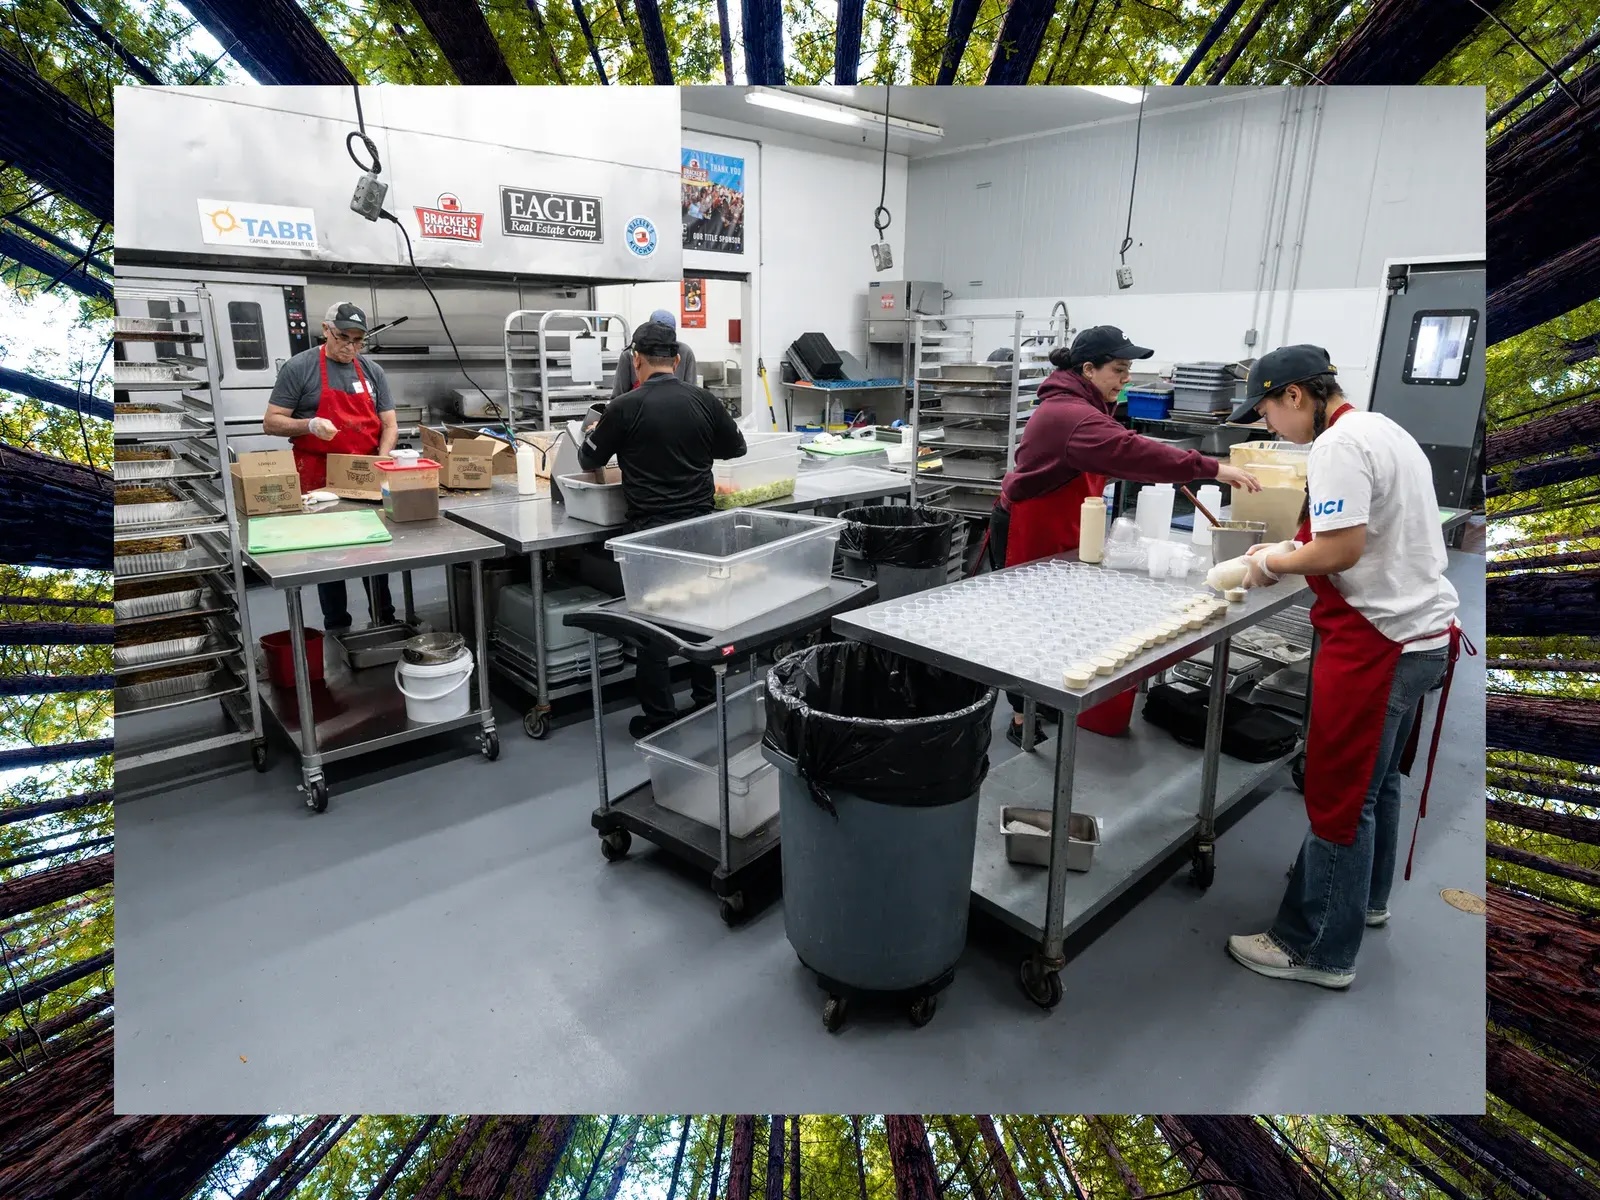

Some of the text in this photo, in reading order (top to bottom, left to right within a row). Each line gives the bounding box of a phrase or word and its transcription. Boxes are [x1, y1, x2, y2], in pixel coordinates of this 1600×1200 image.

[710, 163, 729, 174] THANK
[508, 191, 597, 225] EAGLE
[240, 217, 314, 241] TABR
[423, 211, 477, 229] BRACKEN'S
[424, 223, 478, 239] KITCHEN
[511, 220, 597, 240] Real Estate Group
[692, 232, 704, 241] OUR
[704, 233, 718, 242] TITLE
[718, 235, 741, 244] SPONSOR
[270, 239, 305, 248] MANAGEMENT
[1313, 499, 1345, 517] UCI
